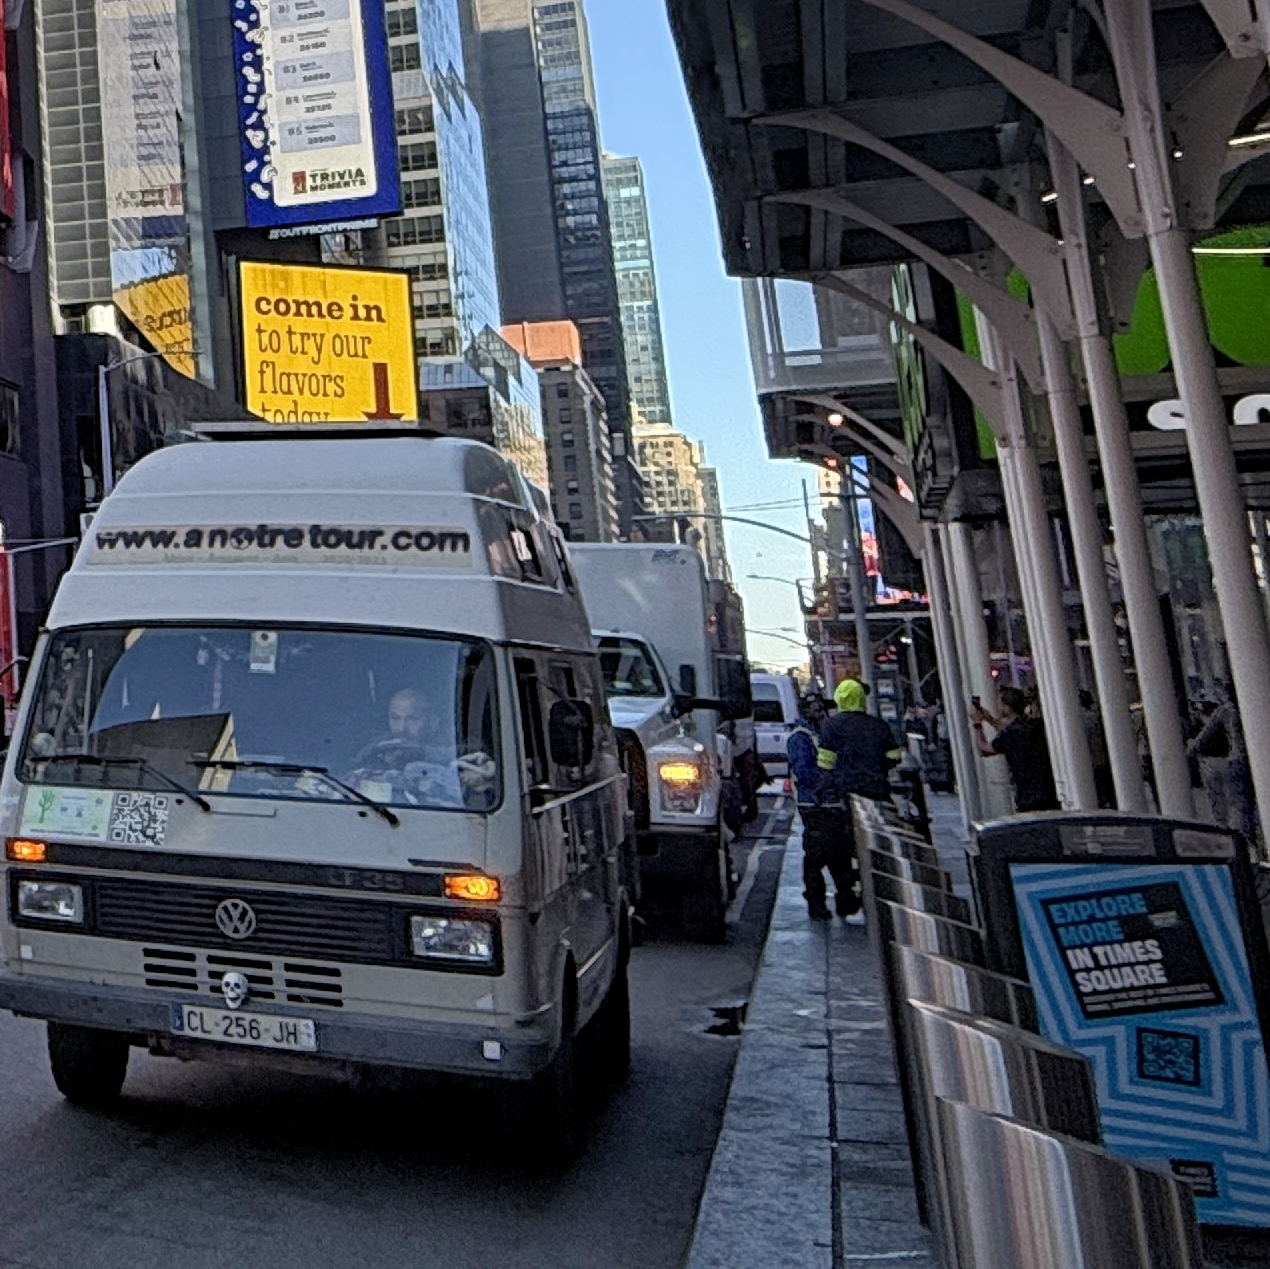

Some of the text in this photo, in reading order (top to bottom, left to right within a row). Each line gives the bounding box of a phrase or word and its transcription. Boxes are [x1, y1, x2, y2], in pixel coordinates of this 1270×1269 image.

[309, 167, 366, 184] TRIVIA
[309, 178, 367, 193] MOMENTS
[254, 294, 386, 324] come in
[257, 322, 372, 368] to try our
[258, 359, 345, 398] flavors
[1048, 892, 1149, 925] EXPLORE
[1057, 919, 1126, 946] MORE
[1066, 938, 1163, 970] IN TIMES
[1074, 962, 1169, 994] SQUARE
